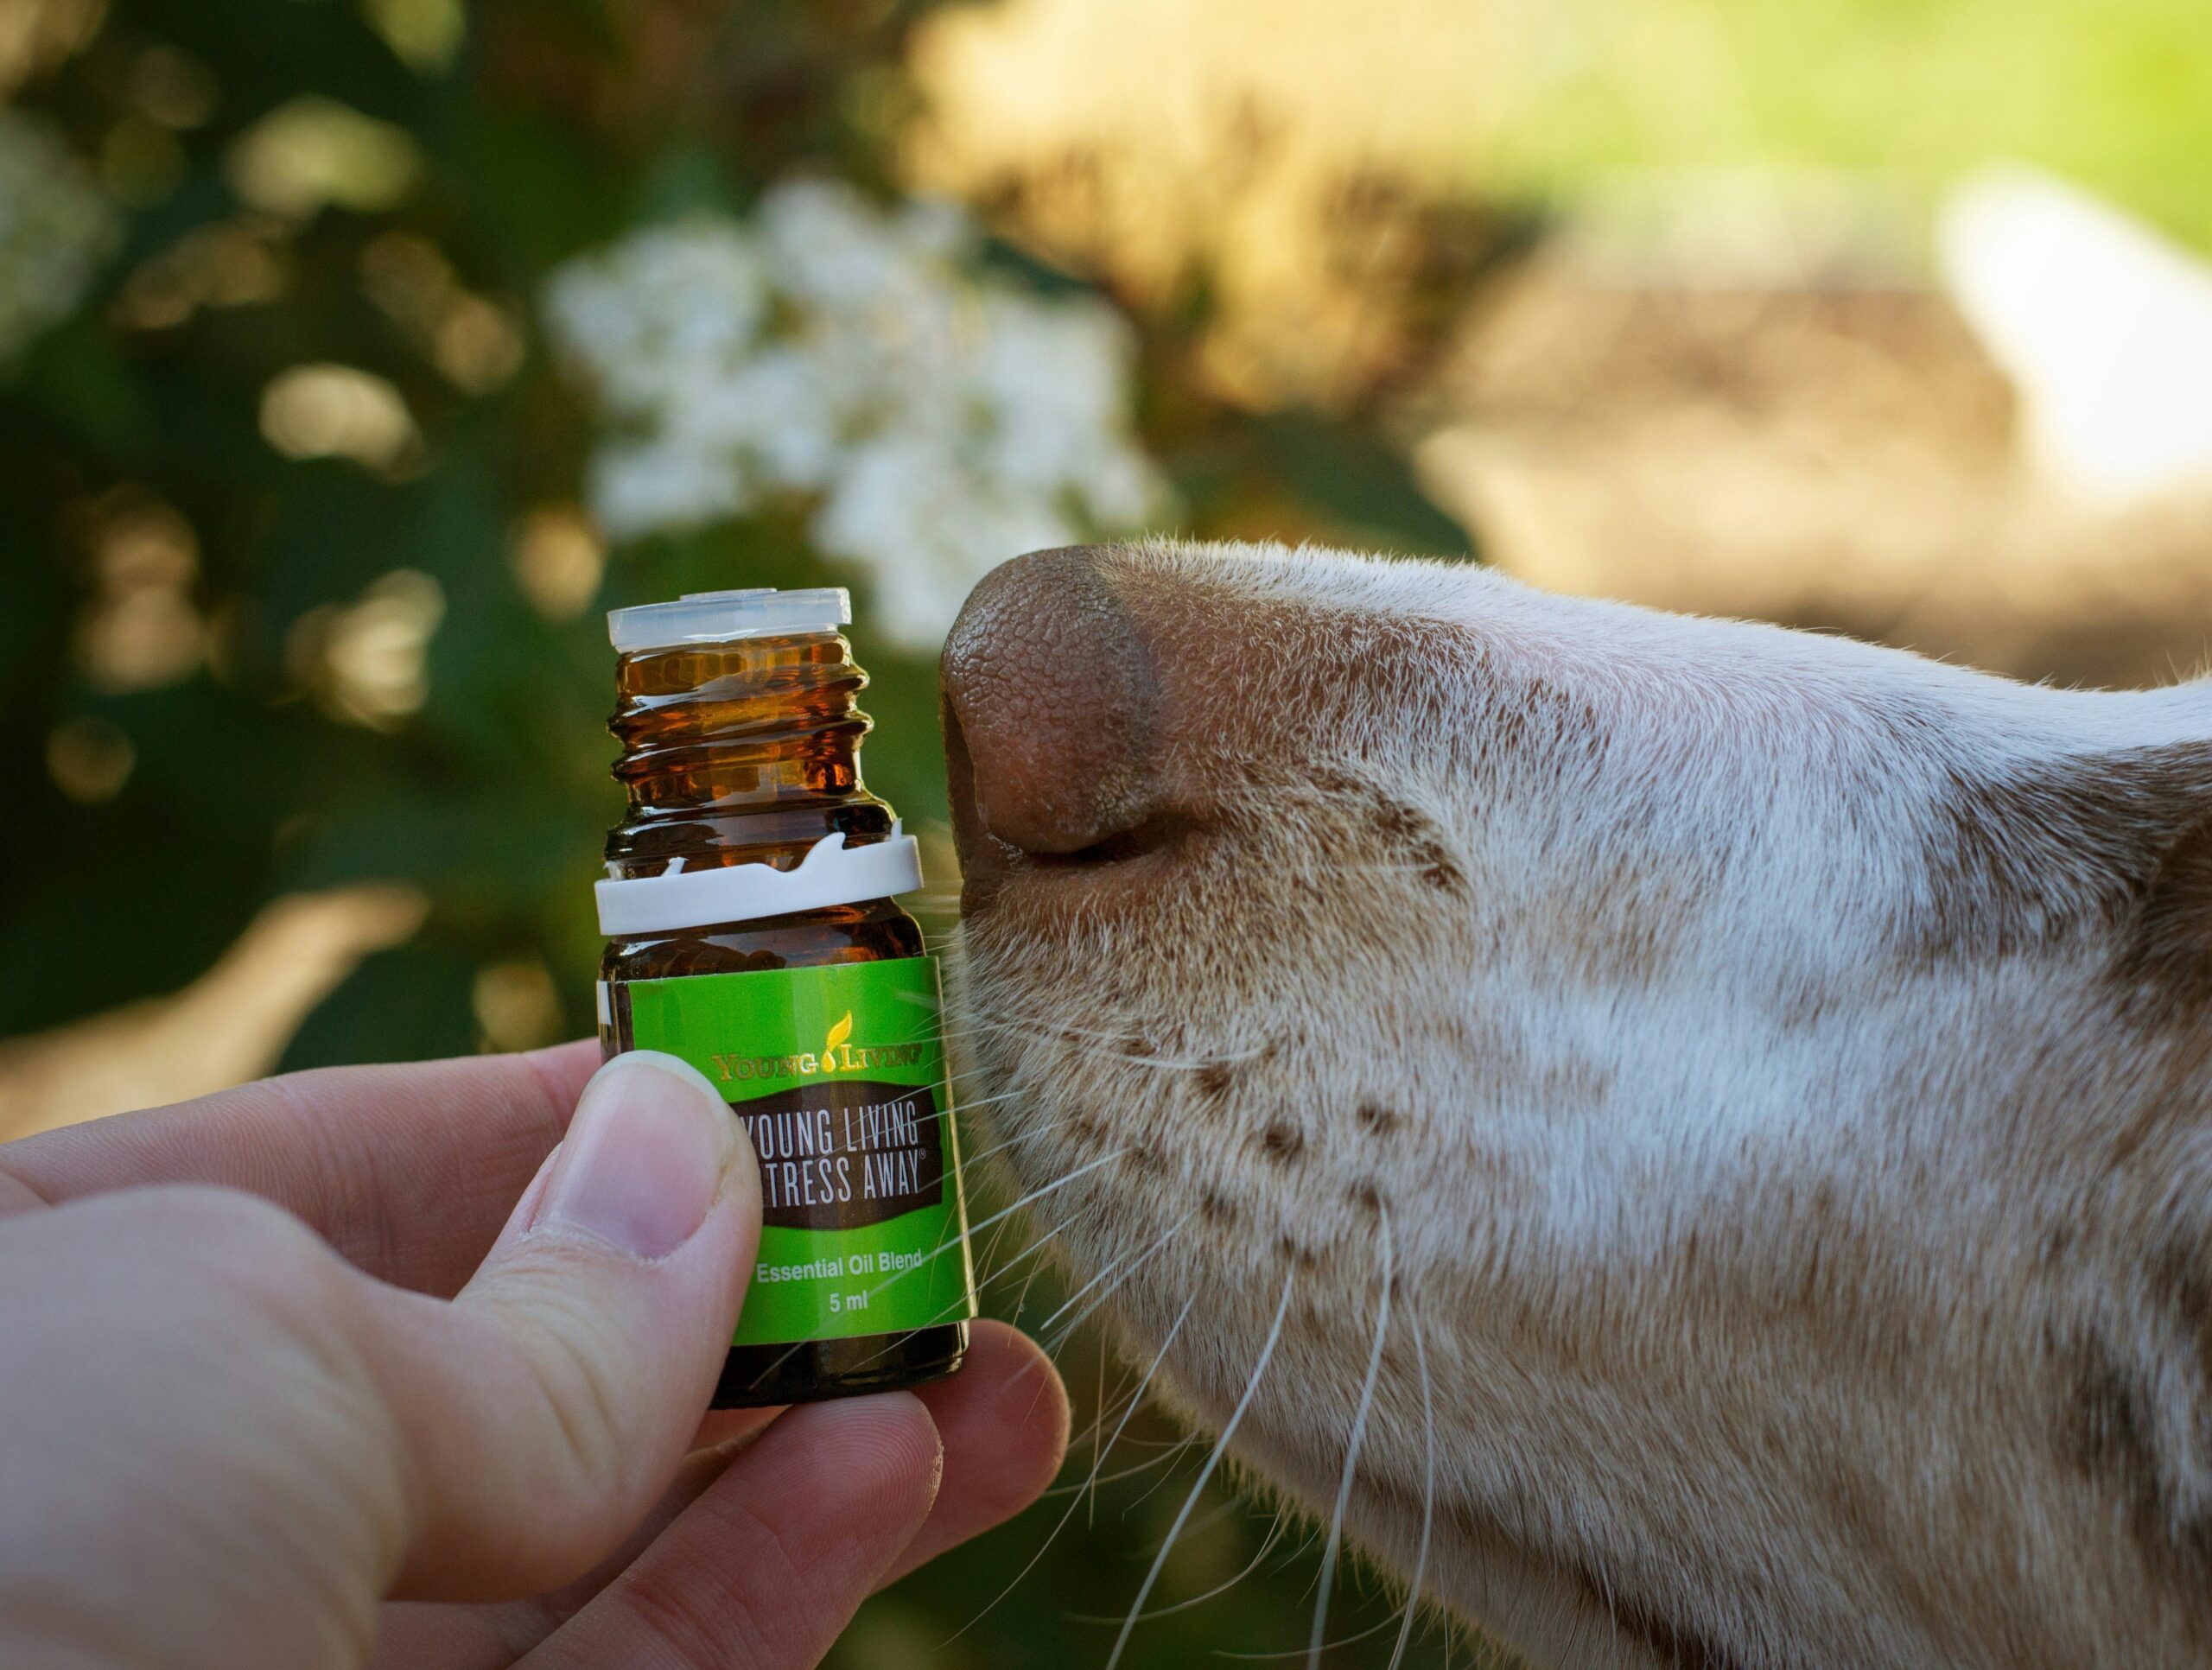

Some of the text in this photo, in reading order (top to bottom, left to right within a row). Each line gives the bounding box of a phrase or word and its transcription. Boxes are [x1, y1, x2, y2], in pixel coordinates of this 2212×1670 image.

[844, 1101, 918, 1152] LIVING
[766, 1157, 851, 1208] TRESS
[757, 1247, 924, 1283] Essential Oil Blend
[830, 1290, 868, 1313] 5 ml
